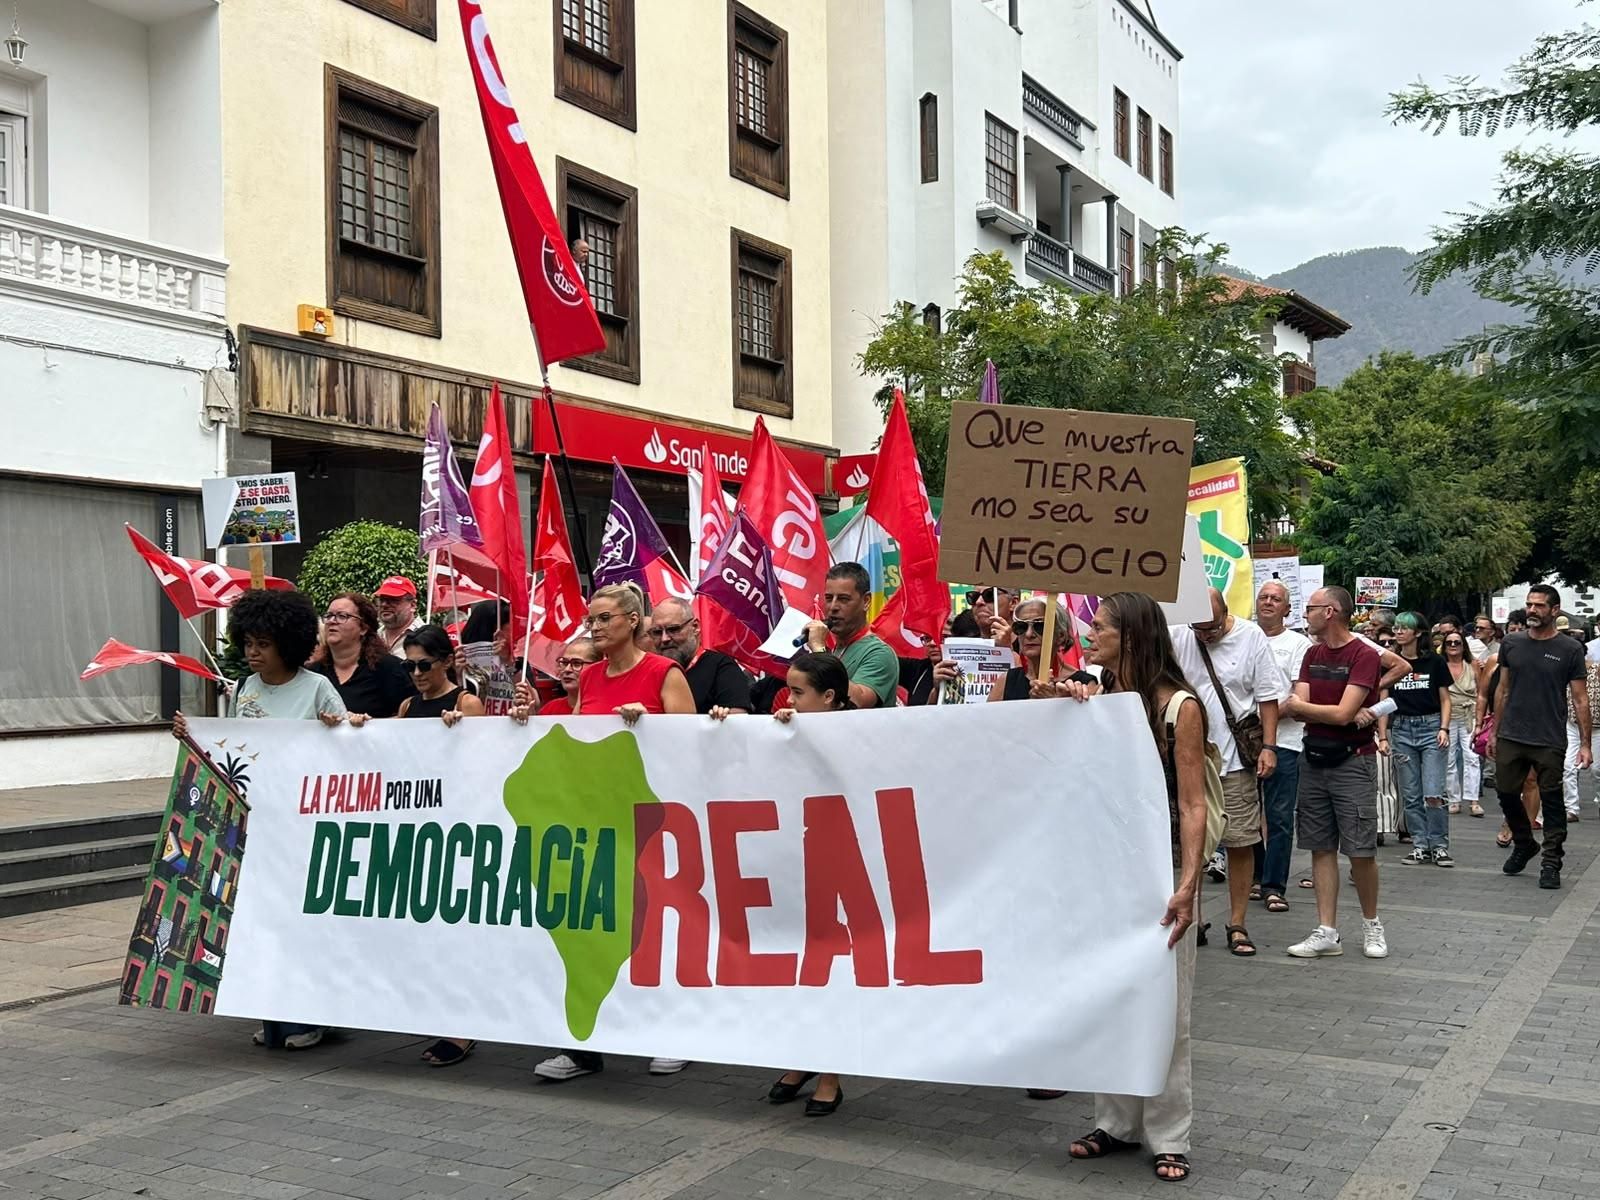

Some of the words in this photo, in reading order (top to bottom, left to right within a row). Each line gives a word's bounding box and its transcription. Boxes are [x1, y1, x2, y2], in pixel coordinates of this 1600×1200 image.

[237, 479, 258, 488] EMOS
[260, 478, 283, 487] SABER
[1014, 458, 1147, 493] TIERRA
[1187, 477, 1236, 497] ecalidad
[235, 497, 258, 507] STRO
[248, 488, 259, 497] SE
[261, 486, 290, 496] GASTA
[1028, 500, 1093, 523] sea
[1113, 507, 1149, 524] su
[974, 537, 1167, 577] NEGOCIO
[299, 774, 321, 814] LA
[325, 771, 382, 814] PALMA
[384, 780, 410, 810] POR
[414, 779, 443, 809] UNA
[630, 787, 983, 987] REAL
